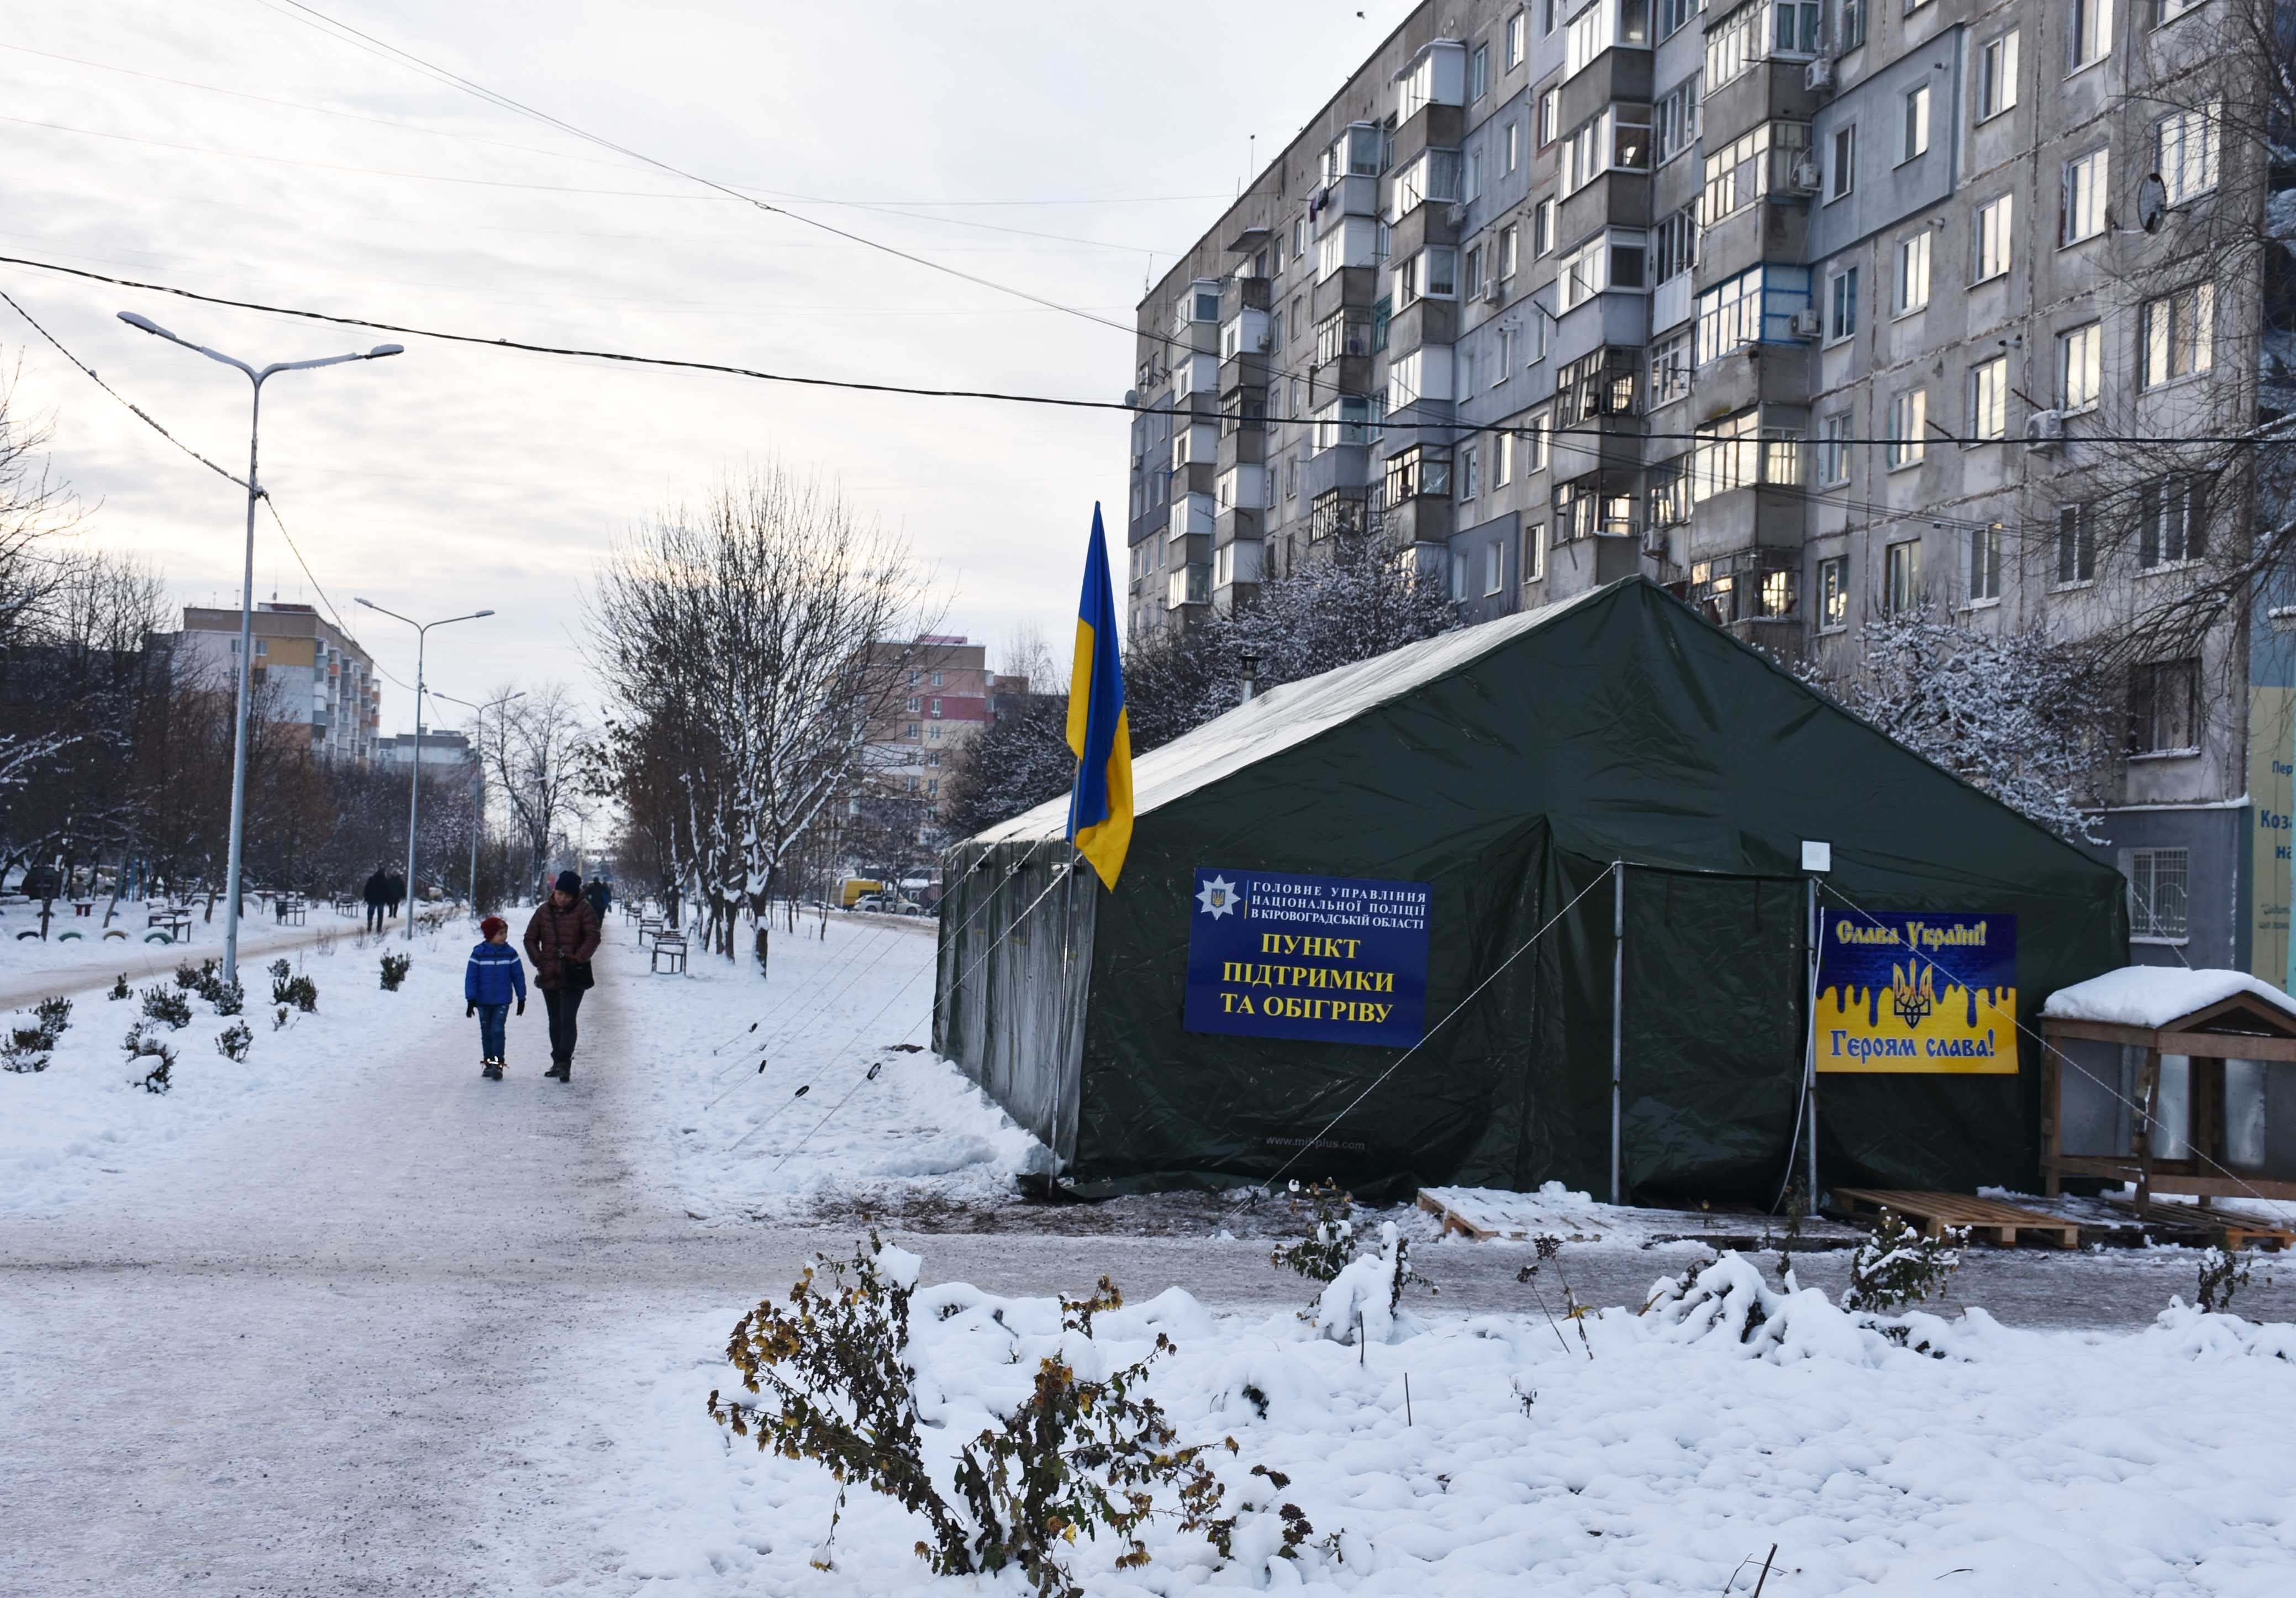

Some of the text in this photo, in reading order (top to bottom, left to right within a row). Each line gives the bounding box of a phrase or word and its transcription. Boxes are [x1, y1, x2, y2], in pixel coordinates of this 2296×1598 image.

[2261, 810, 2292, 829] Коз
[1253, 882, 1426, 902] ГОЛОВНЕ УПРАВЛІННЯ
[1251, 909, 1424, 929] В КІРОВОГРАДСЬКІЙ ОБЛАСТІ
[1252, 896, 1425, 916] НАЦІОНАЛЬНОЇ ПОЛІЦІЇ
[1260, 933, 1361, 959] ПУНКТ
[1836, 920, 1987, 952] Слава Україні!
[1222, 961, 1394, 992] ПІДТРИМКИ
[1220, 993, 1394, 1023] ТА ОБІГРІВУ
[1830, 1028, 1995, 1065] Героям слава!
